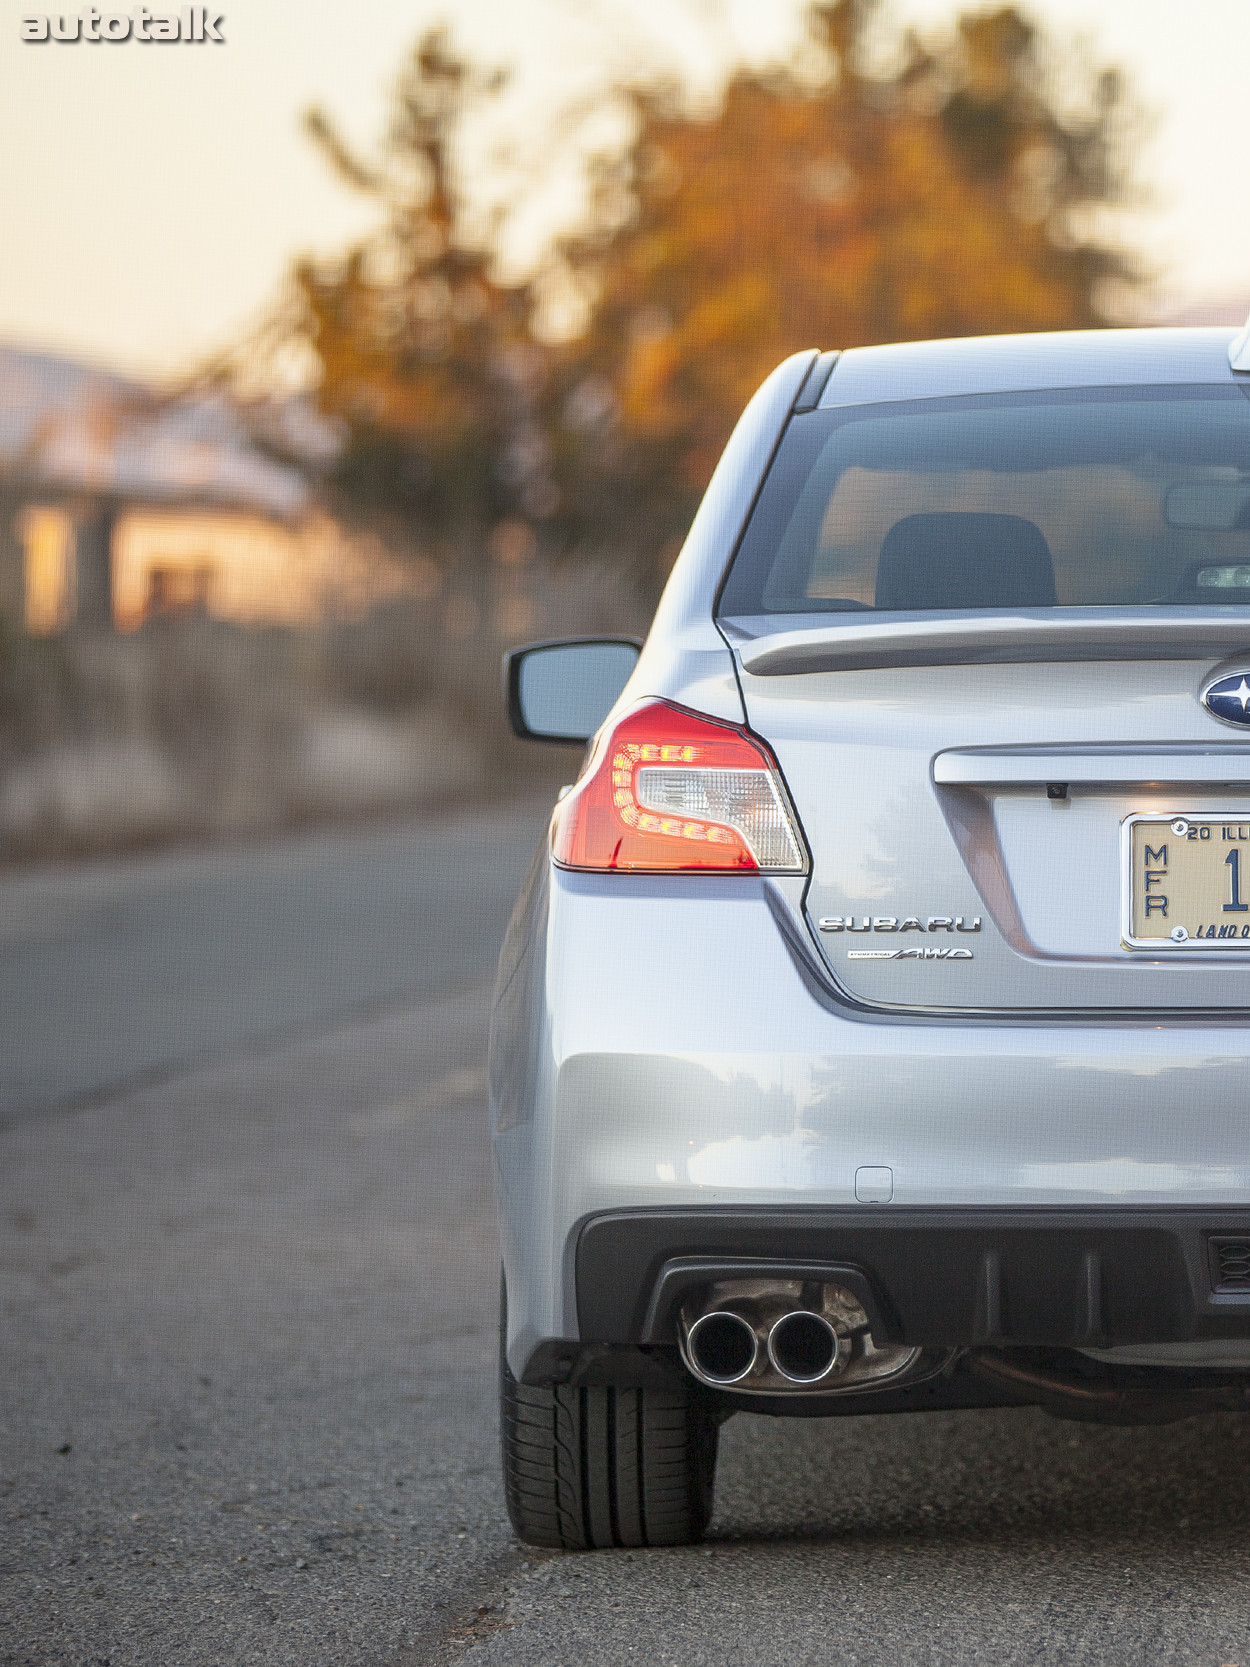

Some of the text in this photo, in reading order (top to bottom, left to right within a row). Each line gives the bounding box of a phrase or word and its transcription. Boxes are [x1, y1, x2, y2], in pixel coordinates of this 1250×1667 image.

[1186, 826, 1211, 840] 20
[1144, 844, 1168, 917] MFR
[818, 916, 982, 933] SUBARU
[1195, 924, 1237, 938] LAND
[894, 948, 974, 960] AWD
